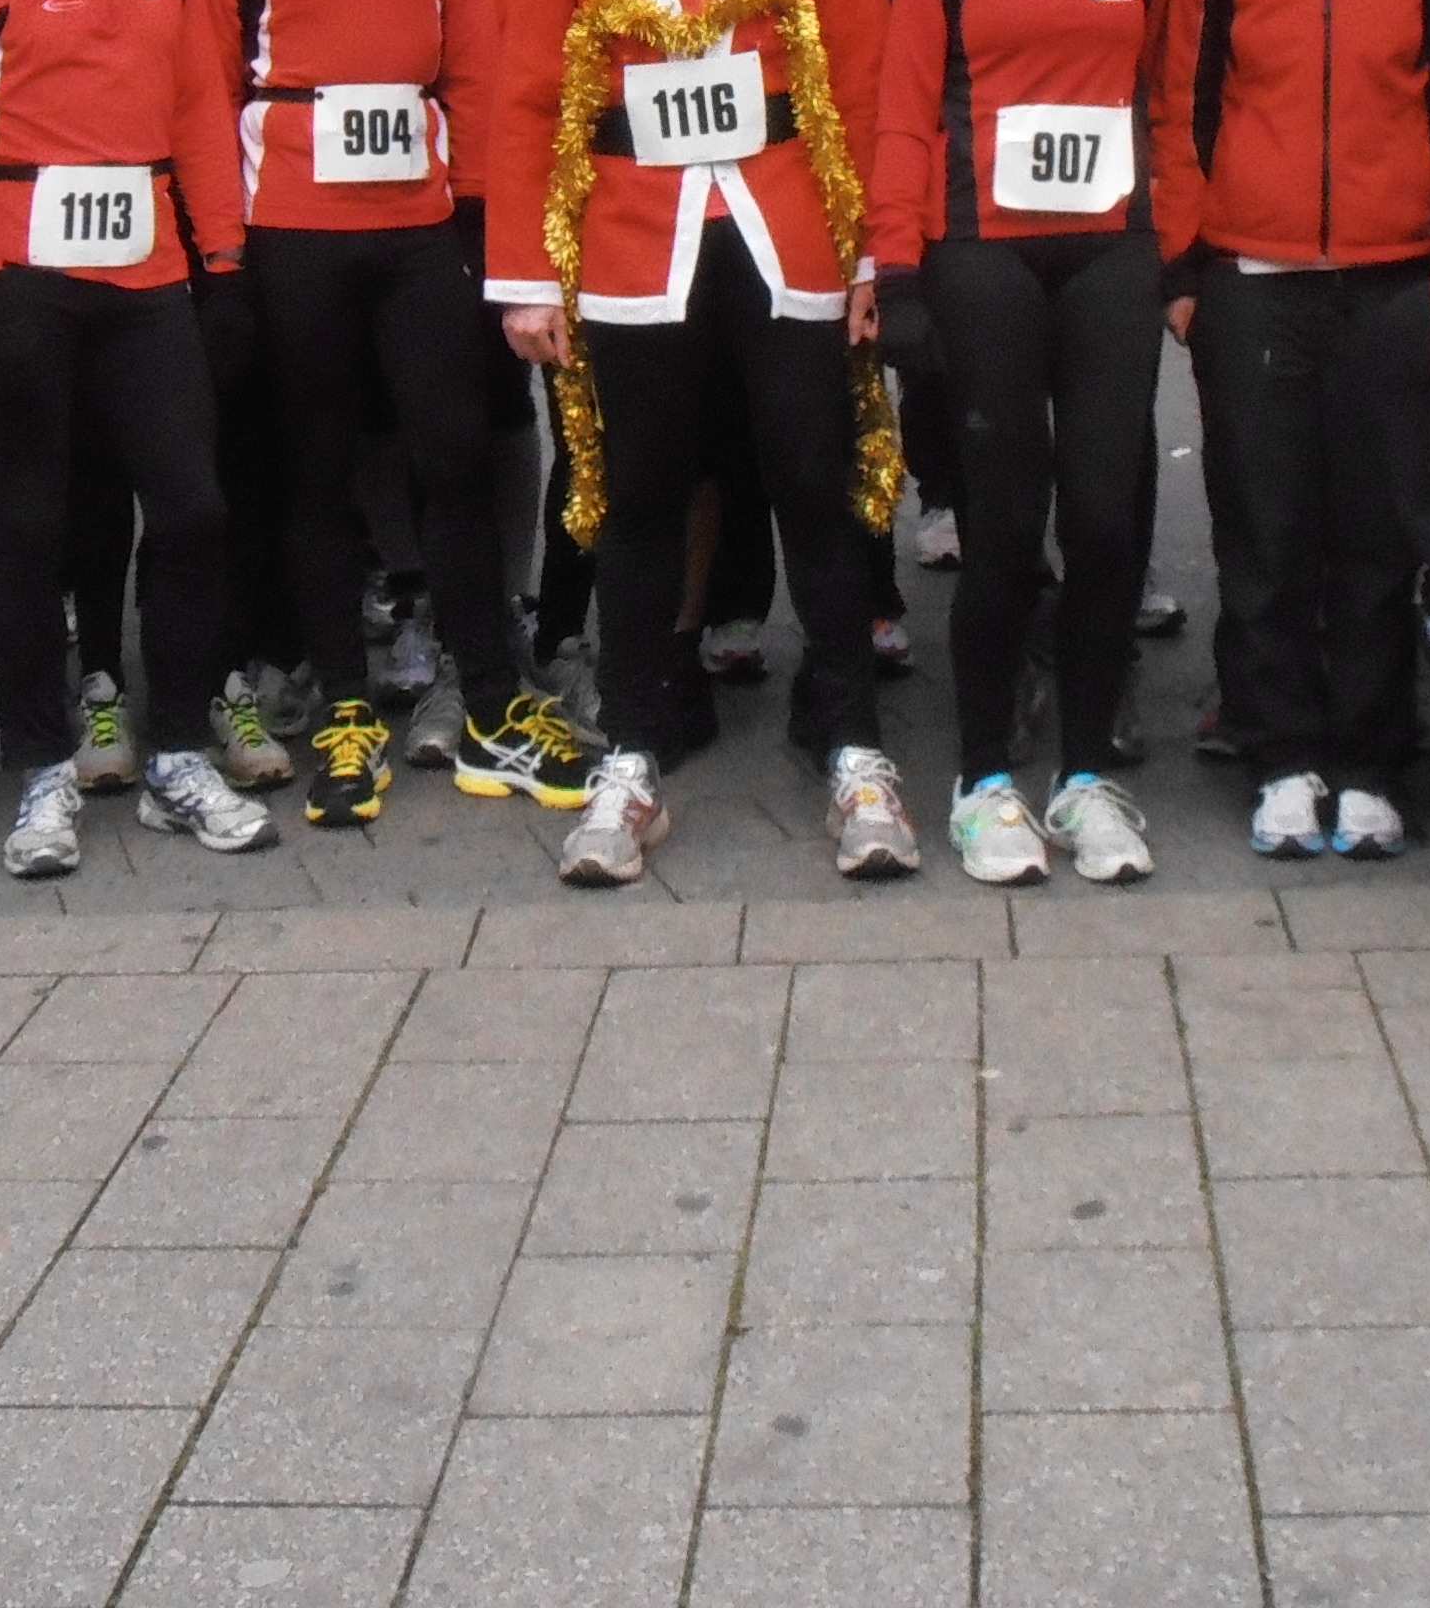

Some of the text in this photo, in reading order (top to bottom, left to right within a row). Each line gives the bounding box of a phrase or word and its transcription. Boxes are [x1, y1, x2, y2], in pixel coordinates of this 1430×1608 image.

[342, 108, 413, 156] 904
[652, 82, 739, 139] 1116
[1031, 131, 1102, 185] 907
[60, 191, 134, 242] 1113
